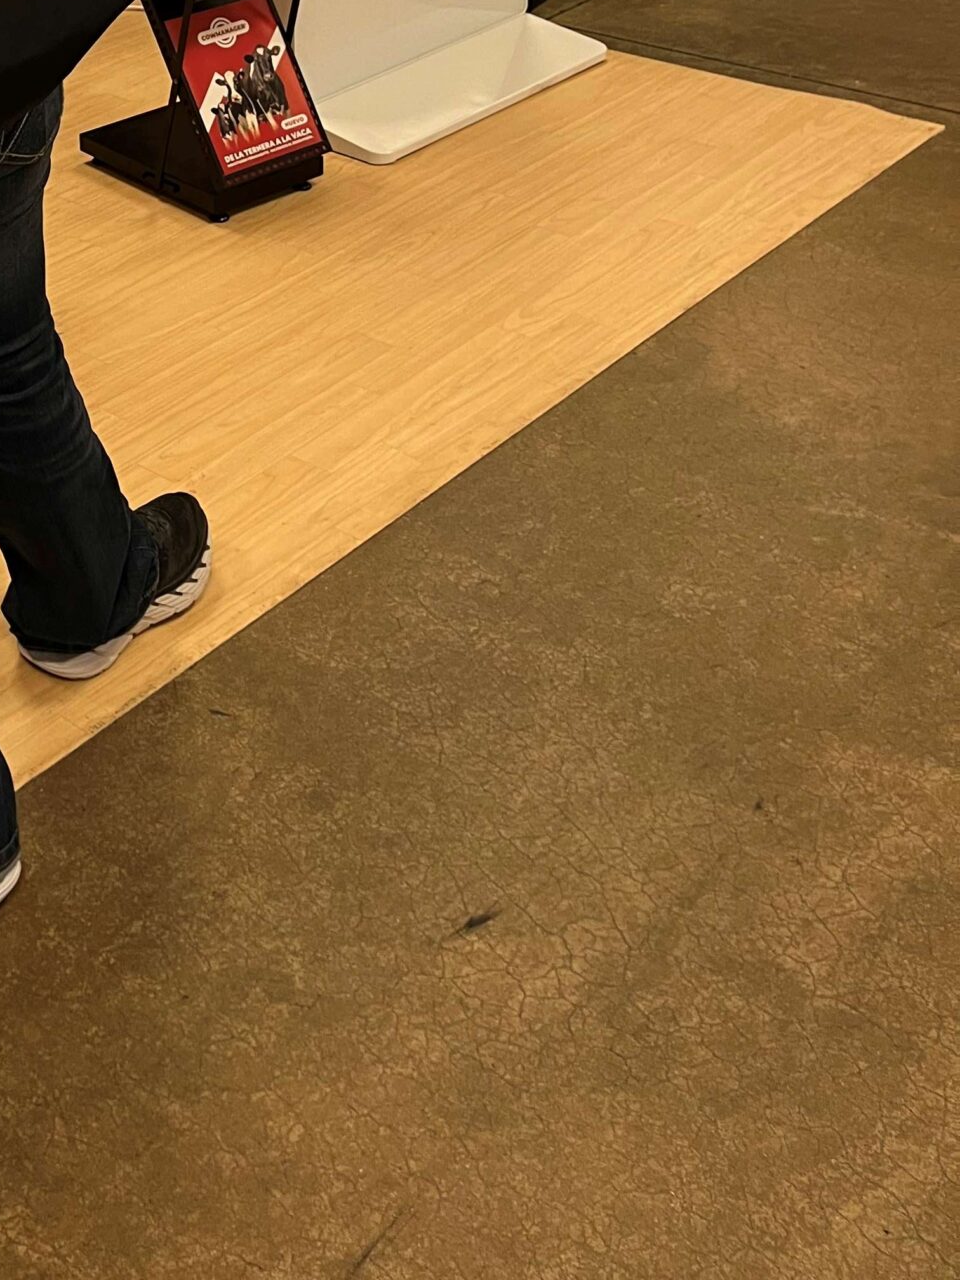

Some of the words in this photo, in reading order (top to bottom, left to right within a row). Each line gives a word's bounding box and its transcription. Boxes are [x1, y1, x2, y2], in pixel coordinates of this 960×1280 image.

[201, 23, 246, 42] COWMANAGER
[224, 154, 234, 164] DE
[234, 152, 244, 161] LA
[243, 140, 276, 157] TERNERA
[275, 138, 282, 146] A
[281, 135, 292, 144] LA
[290, 127, 313, 140] VACA
